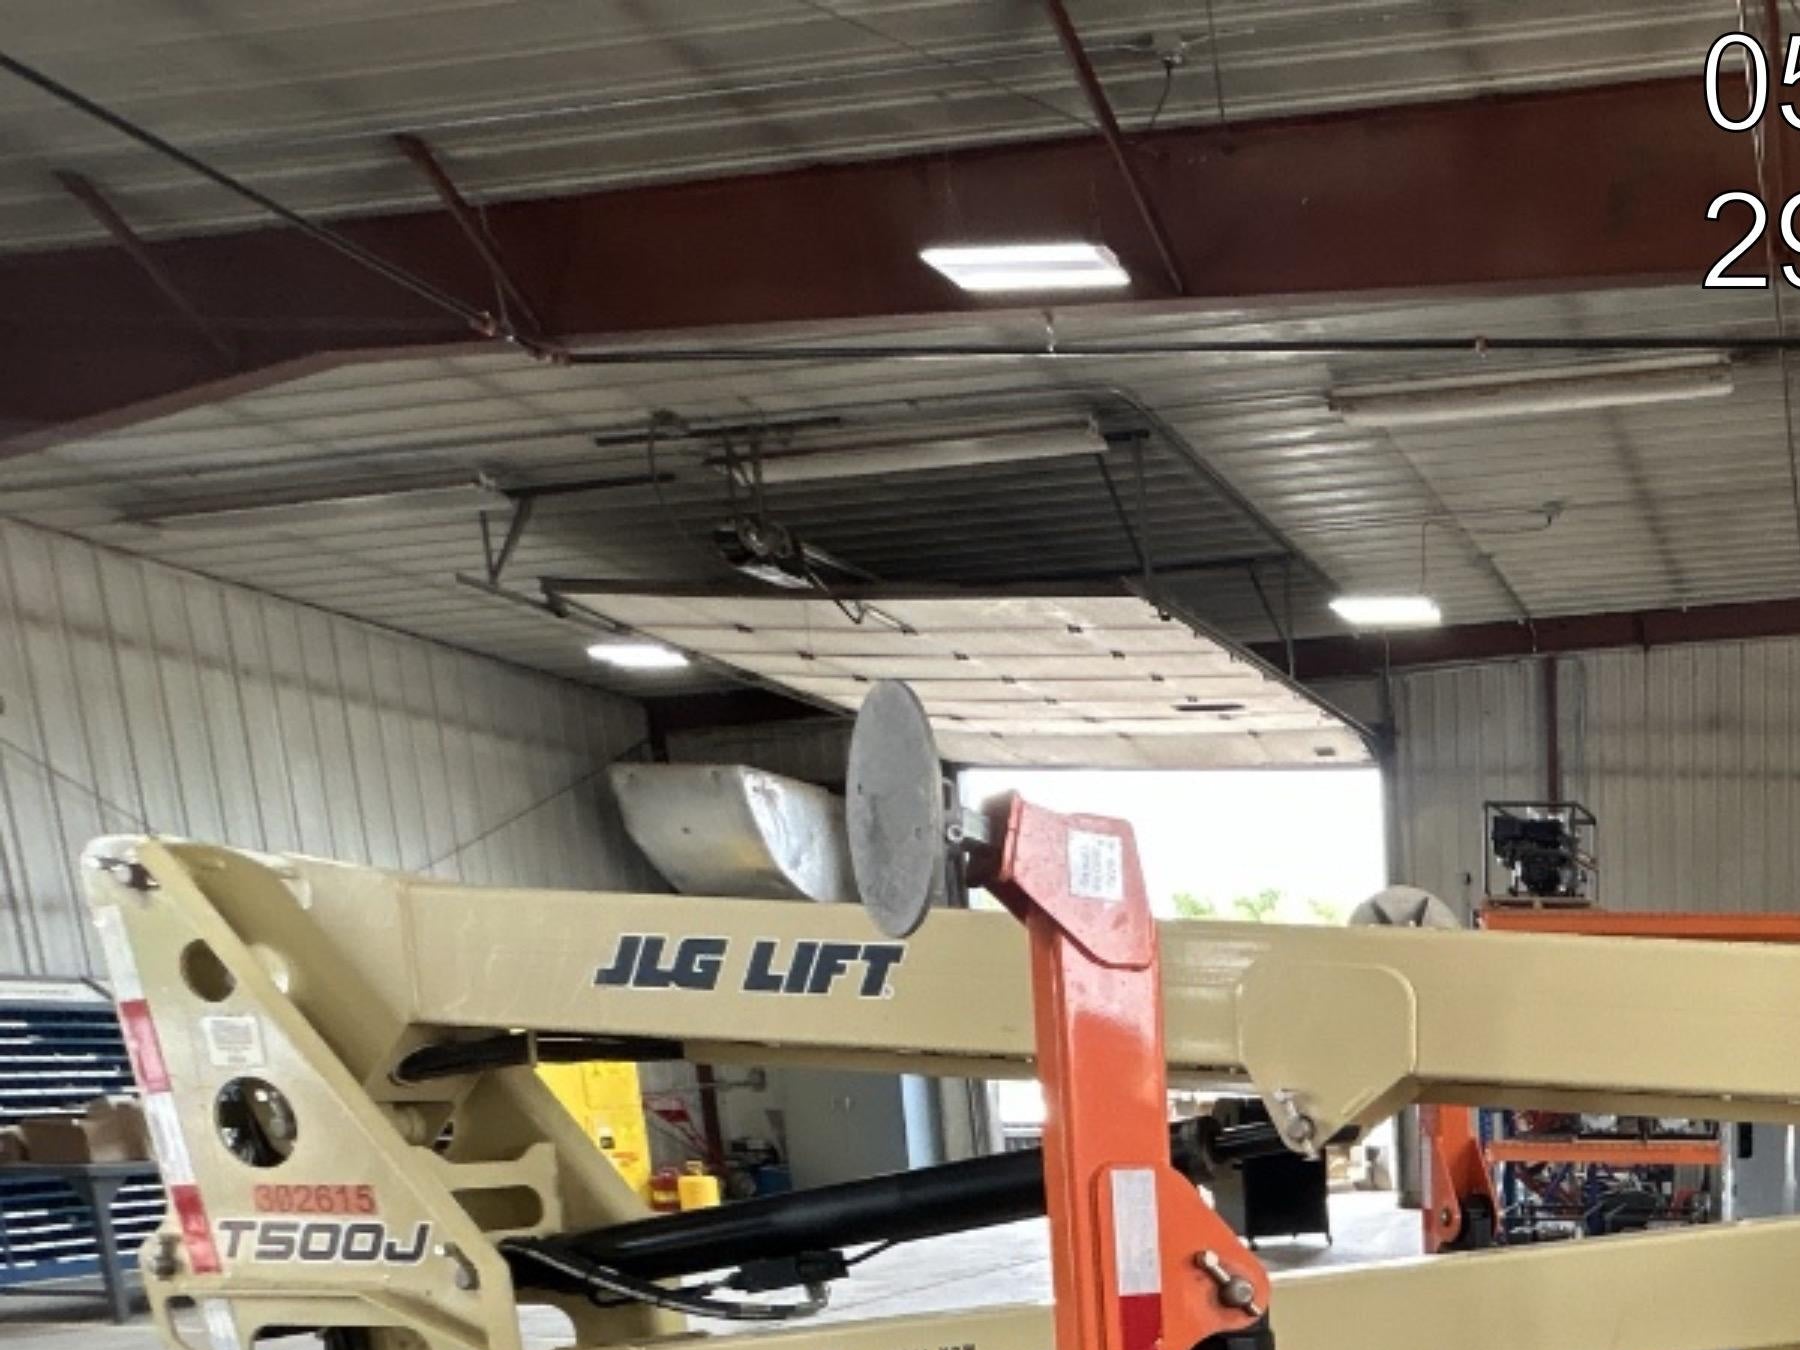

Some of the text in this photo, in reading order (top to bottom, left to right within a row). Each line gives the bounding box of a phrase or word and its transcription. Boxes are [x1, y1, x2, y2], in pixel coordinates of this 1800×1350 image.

[593, 934, 906, 998] JLG LIFT
[216, 1219, 432, 1264] T500J
